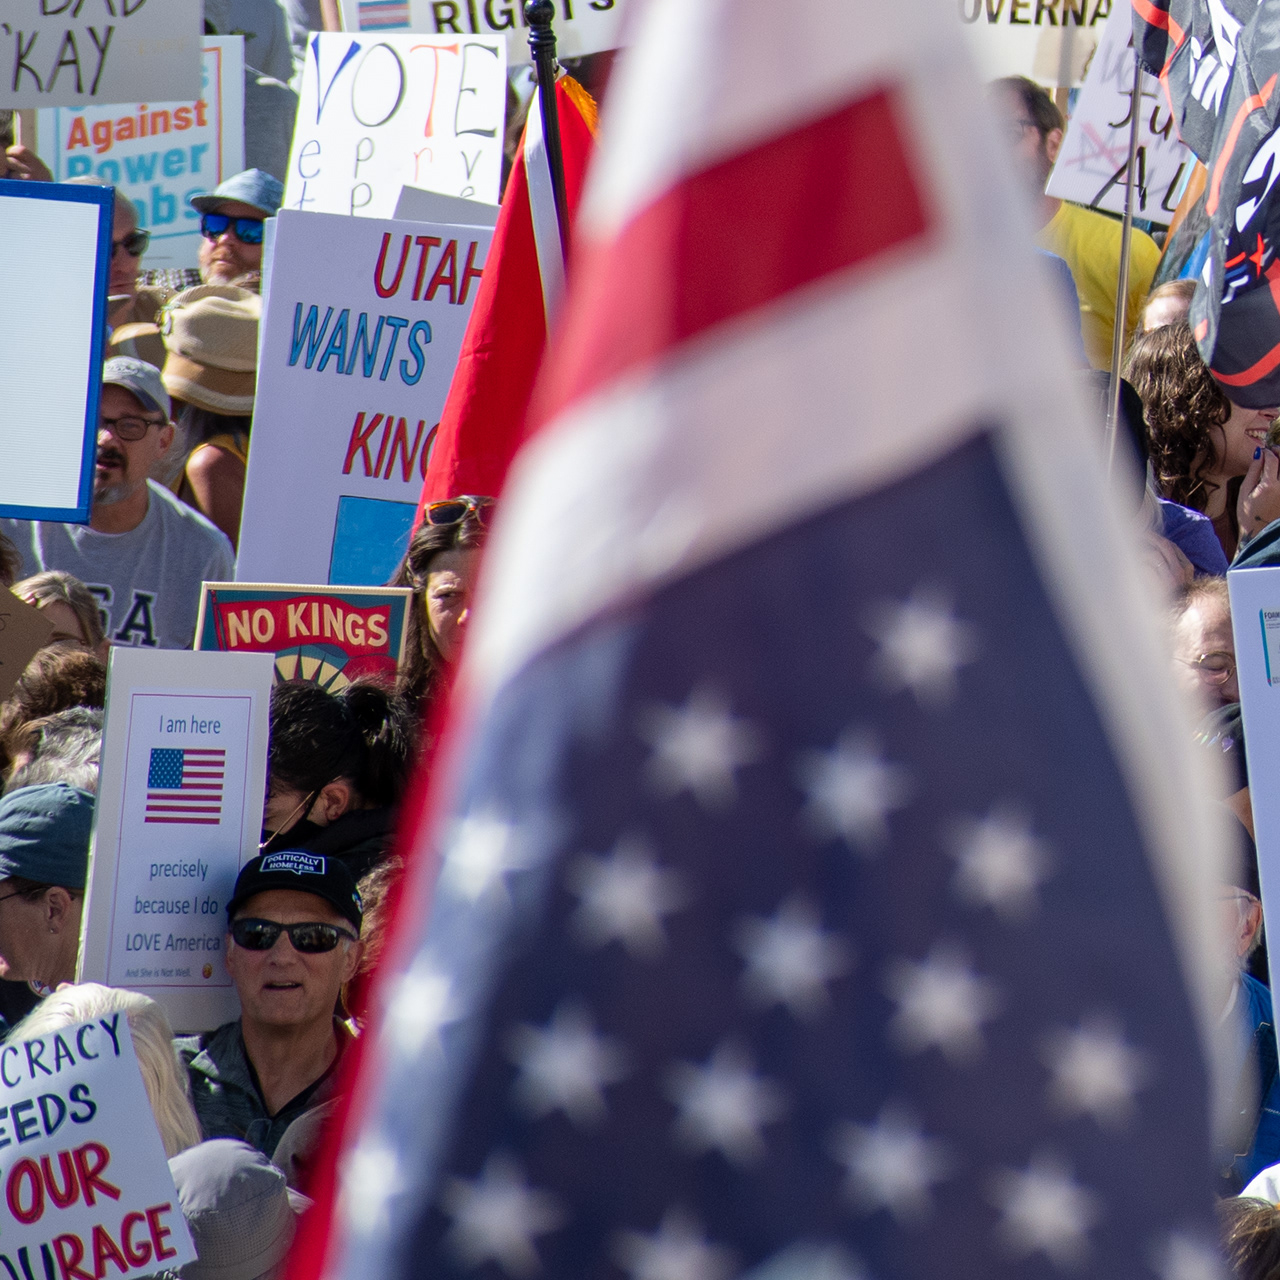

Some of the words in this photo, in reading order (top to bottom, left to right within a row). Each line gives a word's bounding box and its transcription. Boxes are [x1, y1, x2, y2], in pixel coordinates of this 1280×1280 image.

[309, 41, 500, 141] VOTE
[66, 99, 208, 154] Against
[67, 142, 210, 185] Power
[286, 301, 432, 387] WANTS
[86, 582, 157, 648] SA
[228, 607, 275, 649] NO
[287, 601, 389, 648] KINGS
[167, 718, 187, 734] am
[191, 714, 222, 734] here
[150, 859, 208, 882] precisely
[267, 853, 320, 866] POLITICALLY
[269, 860, 315, 872] HOMELESS
[135, 895, 192, 914] because
[201, 896, 219, 915] do
[126, 933, 161, 951] LOVE
[164, 933, 221, 951] America
[6, 1141, 122, 1225] OUR
